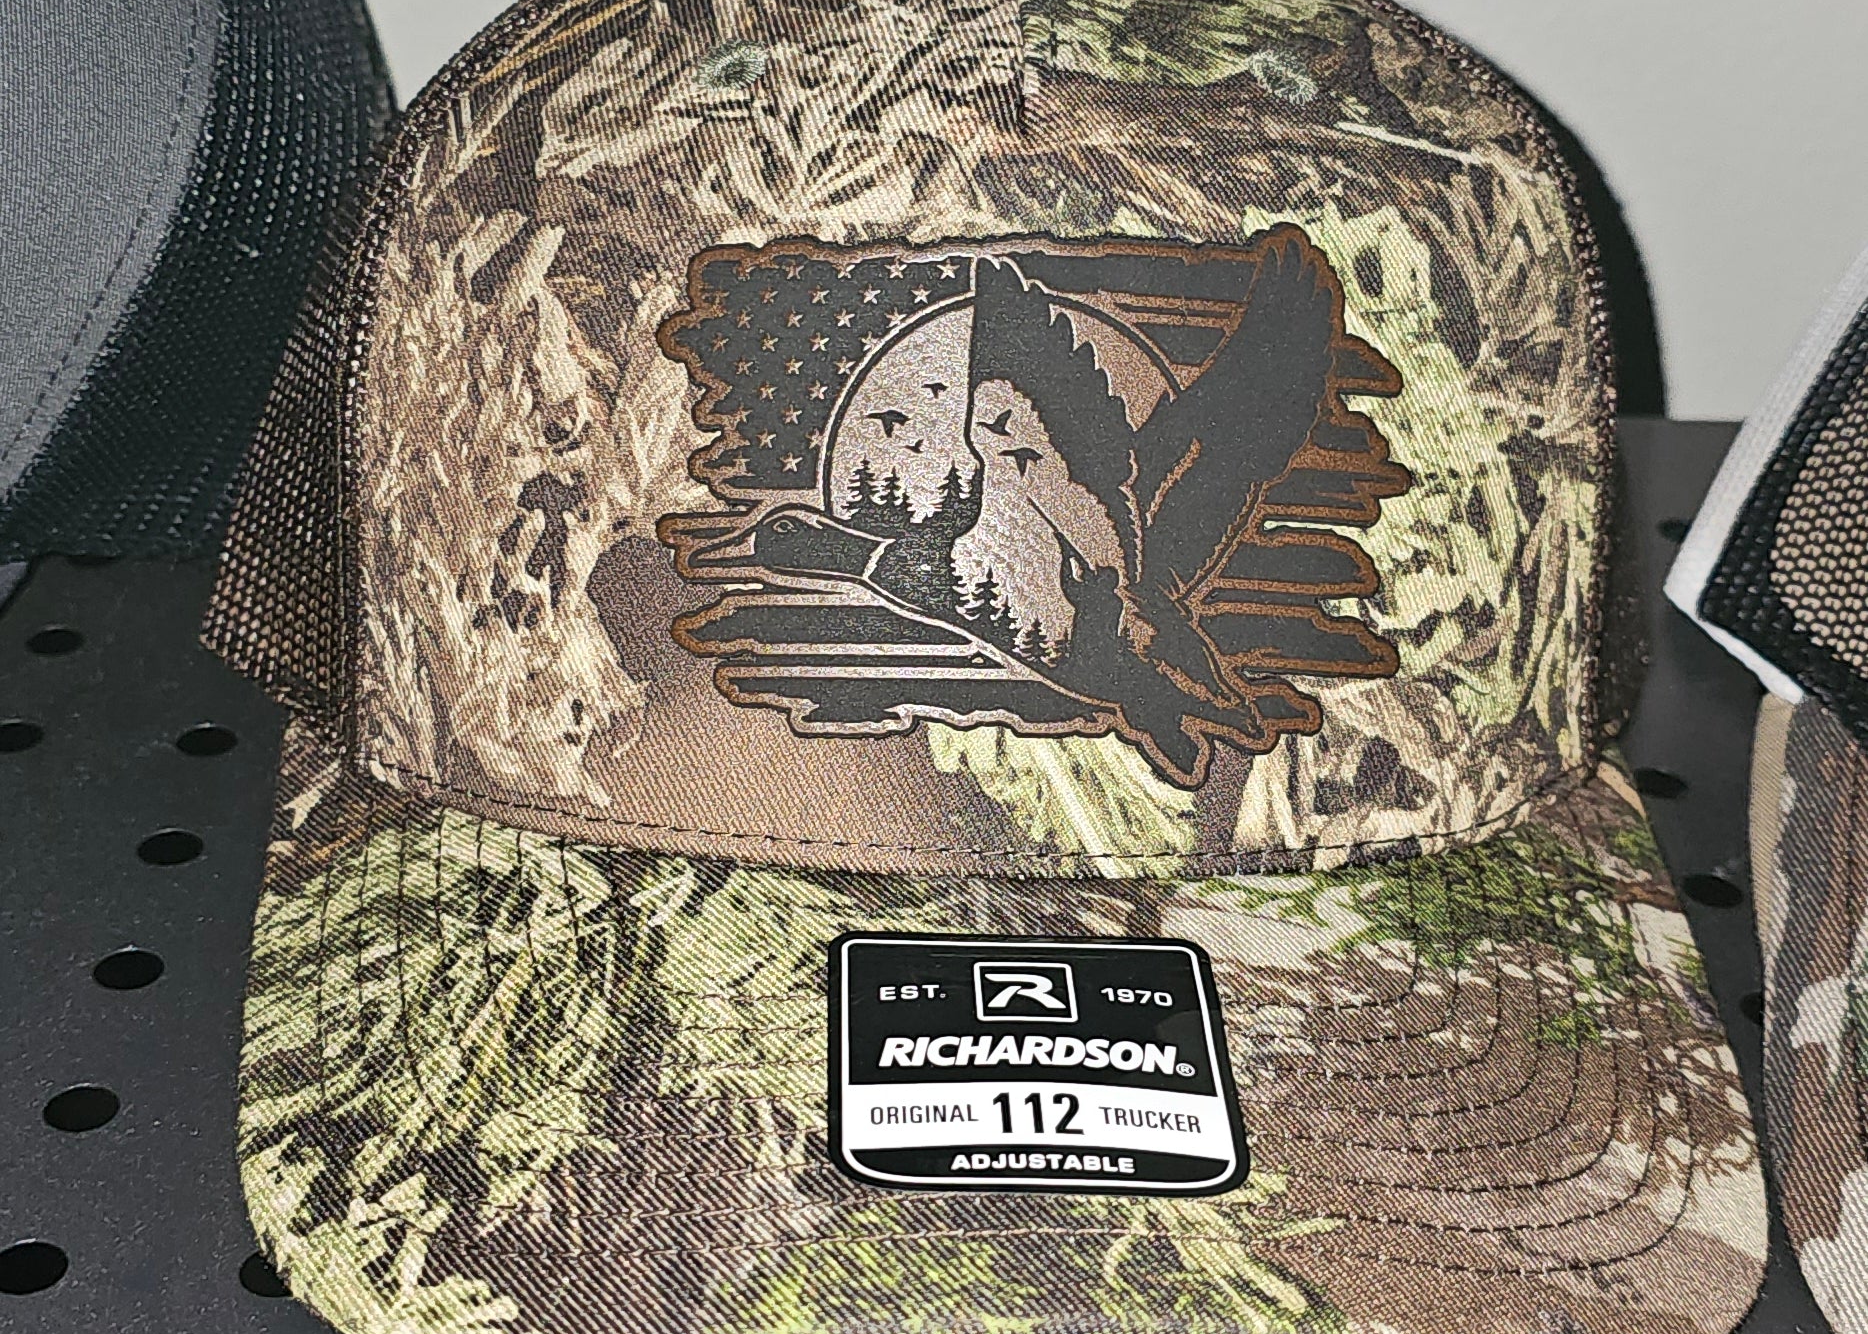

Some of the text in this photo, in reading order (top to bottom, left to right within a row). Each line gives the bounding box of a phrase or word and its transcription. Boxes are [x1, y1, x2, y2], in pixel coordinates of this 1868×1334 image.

[879, 984, 946, 1001] EST.
[1101, 987, 1173, 1007] 1970
[870, 1092, 1202, 1135] ORIGINAL 112 TRUCKER
[950, 1153, 1136, 1174] ADJUSTABLE
